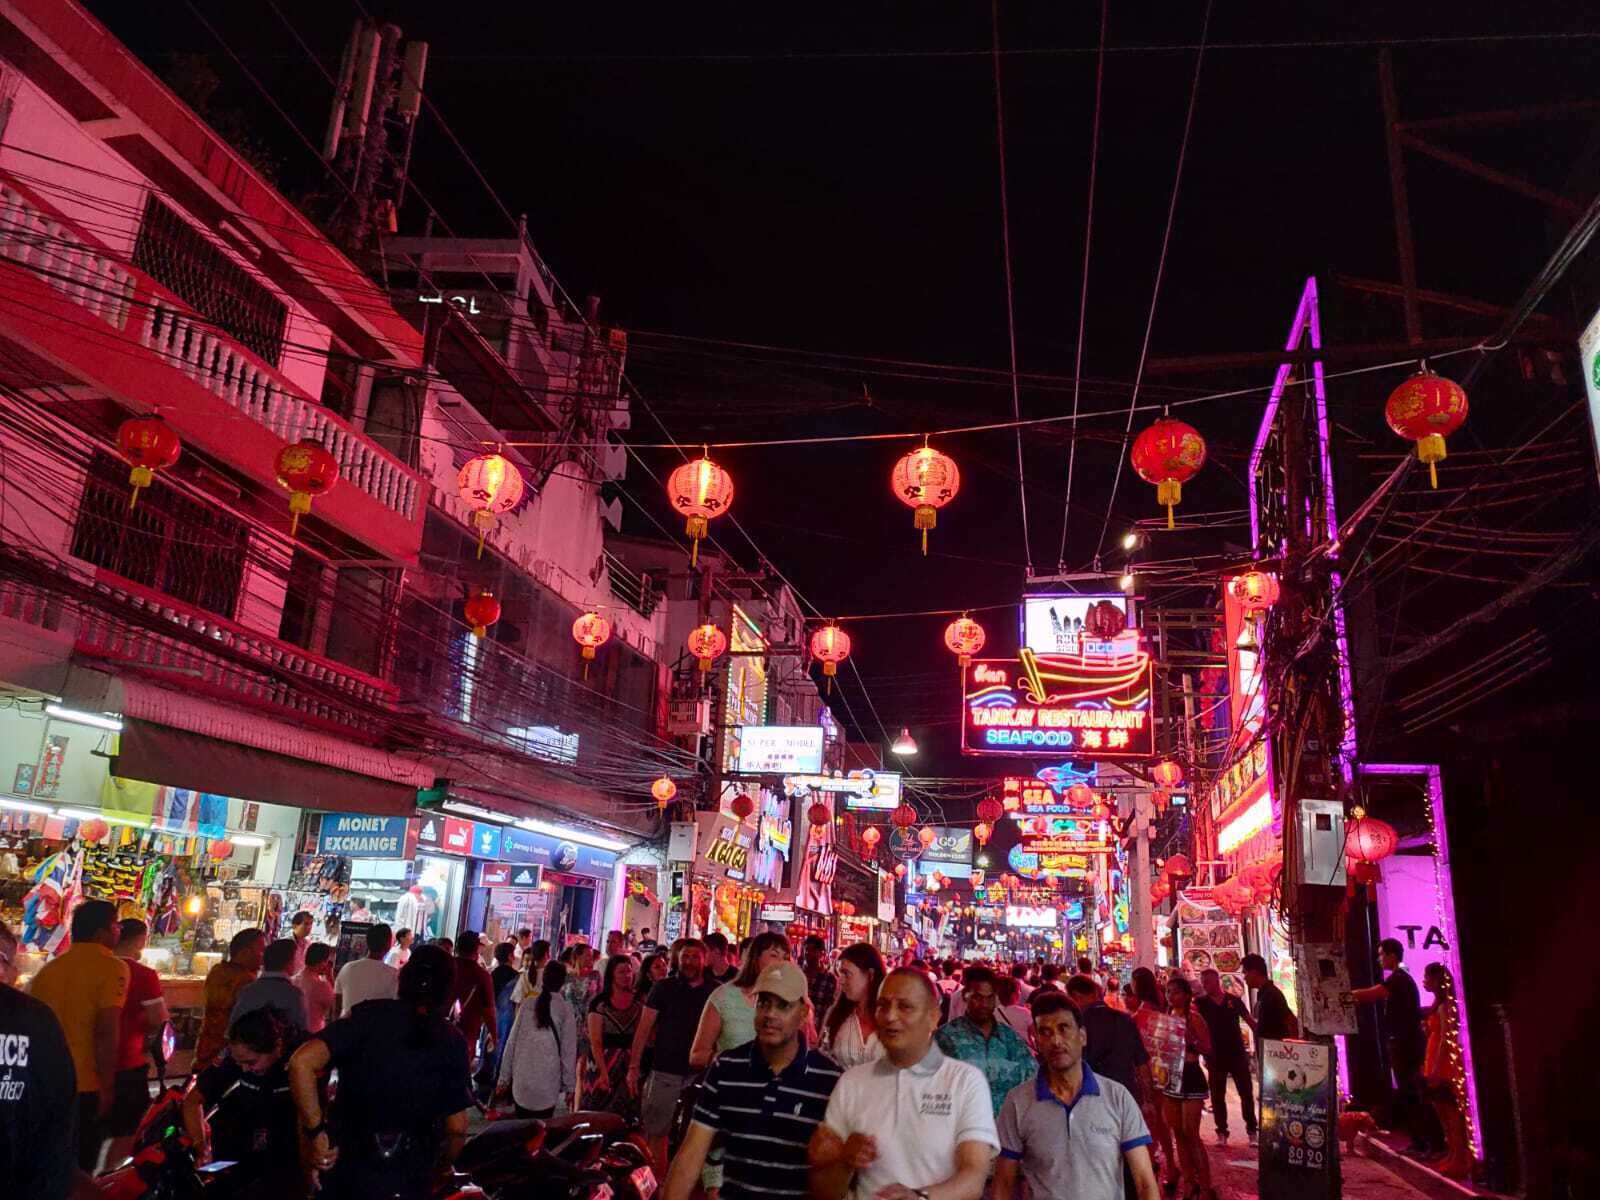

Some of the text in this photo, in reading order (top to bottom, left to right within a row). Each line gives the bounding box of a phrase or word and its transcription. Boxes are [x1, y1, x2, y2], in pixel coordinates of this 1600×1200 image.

[971, 708, 1146, 729] TANKAY RESTAURANT
[986, 729, 1073, 746] SEAFOOD
[337, 817, 390, 832] MONEY
[324, 836, 398, 851] EXCHANGE
[1288, 1145, 1323, 1163] 80 90
